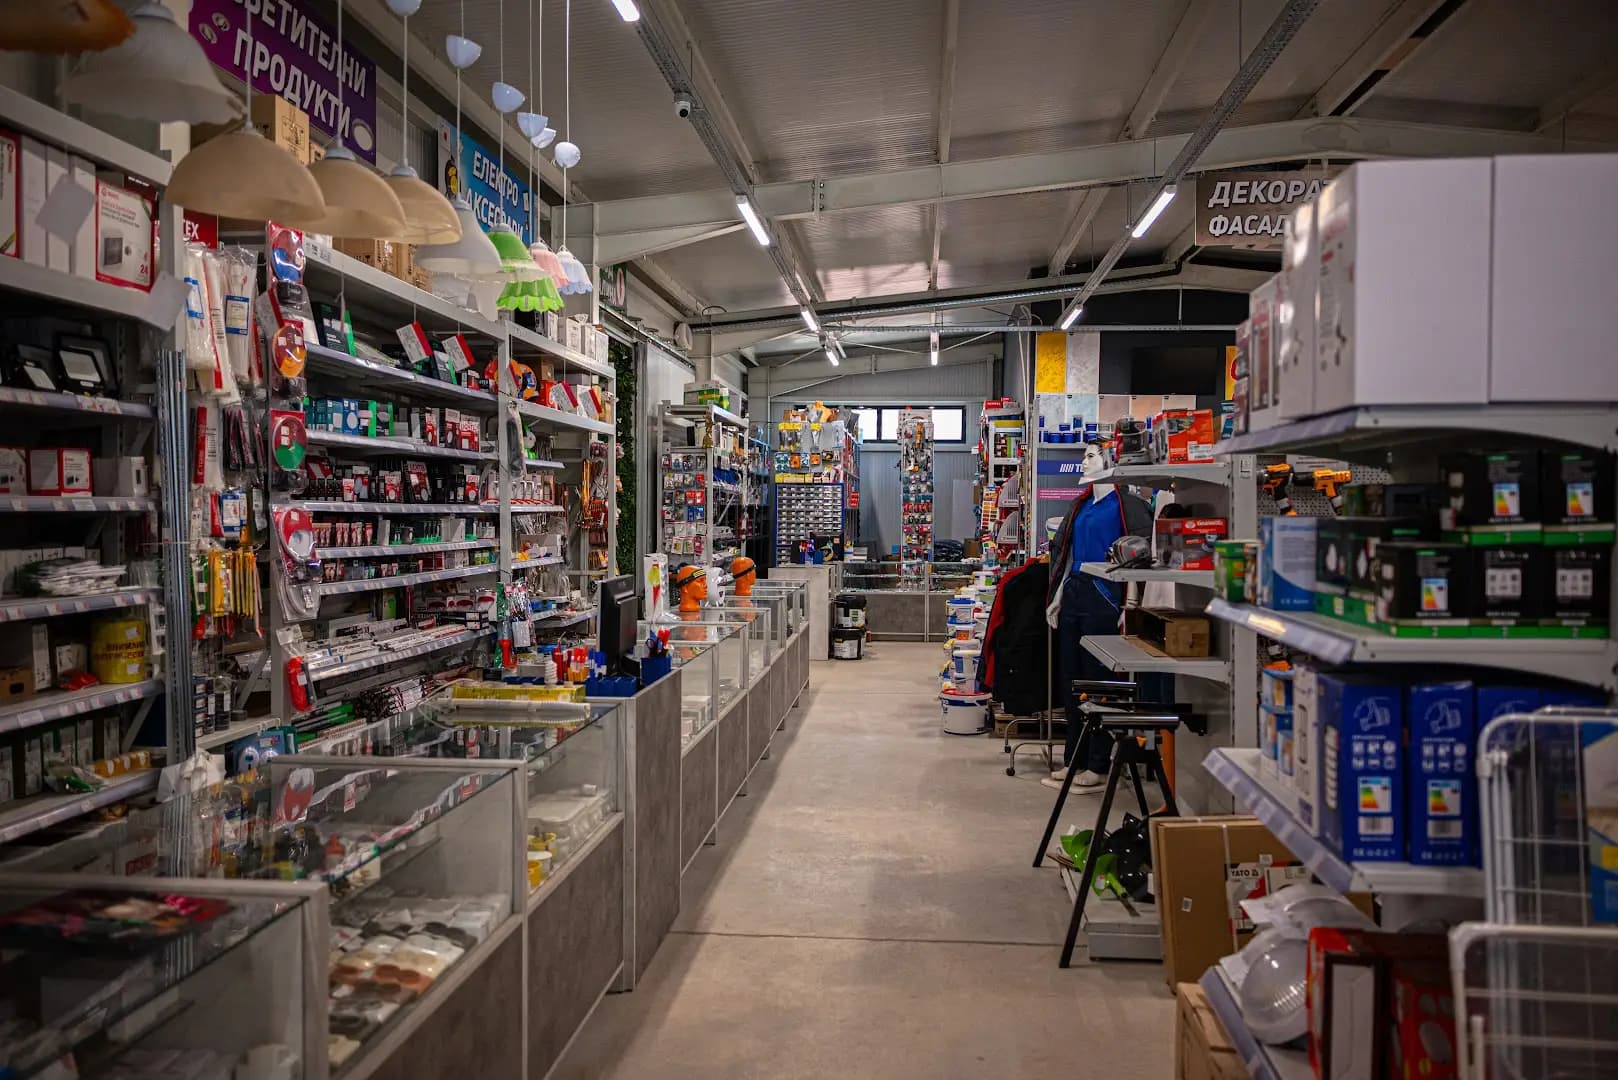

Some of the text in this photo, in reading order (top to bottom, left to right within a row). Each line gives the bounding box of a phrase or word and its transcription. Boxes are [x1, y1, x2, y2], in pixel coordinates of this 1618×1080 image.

[233, 0, 367, 98] ВЕТИТЕЛНИ
[233, 28, 351, 139] ПРОДУКТИ
[473, 150, 519, 207] ЕЛЕКТРО
[1208, 179, 1329, 208] ДЕКОРА
[183, 219, 199, 240] EX
[1231, 869, 1250, 877] YATO
